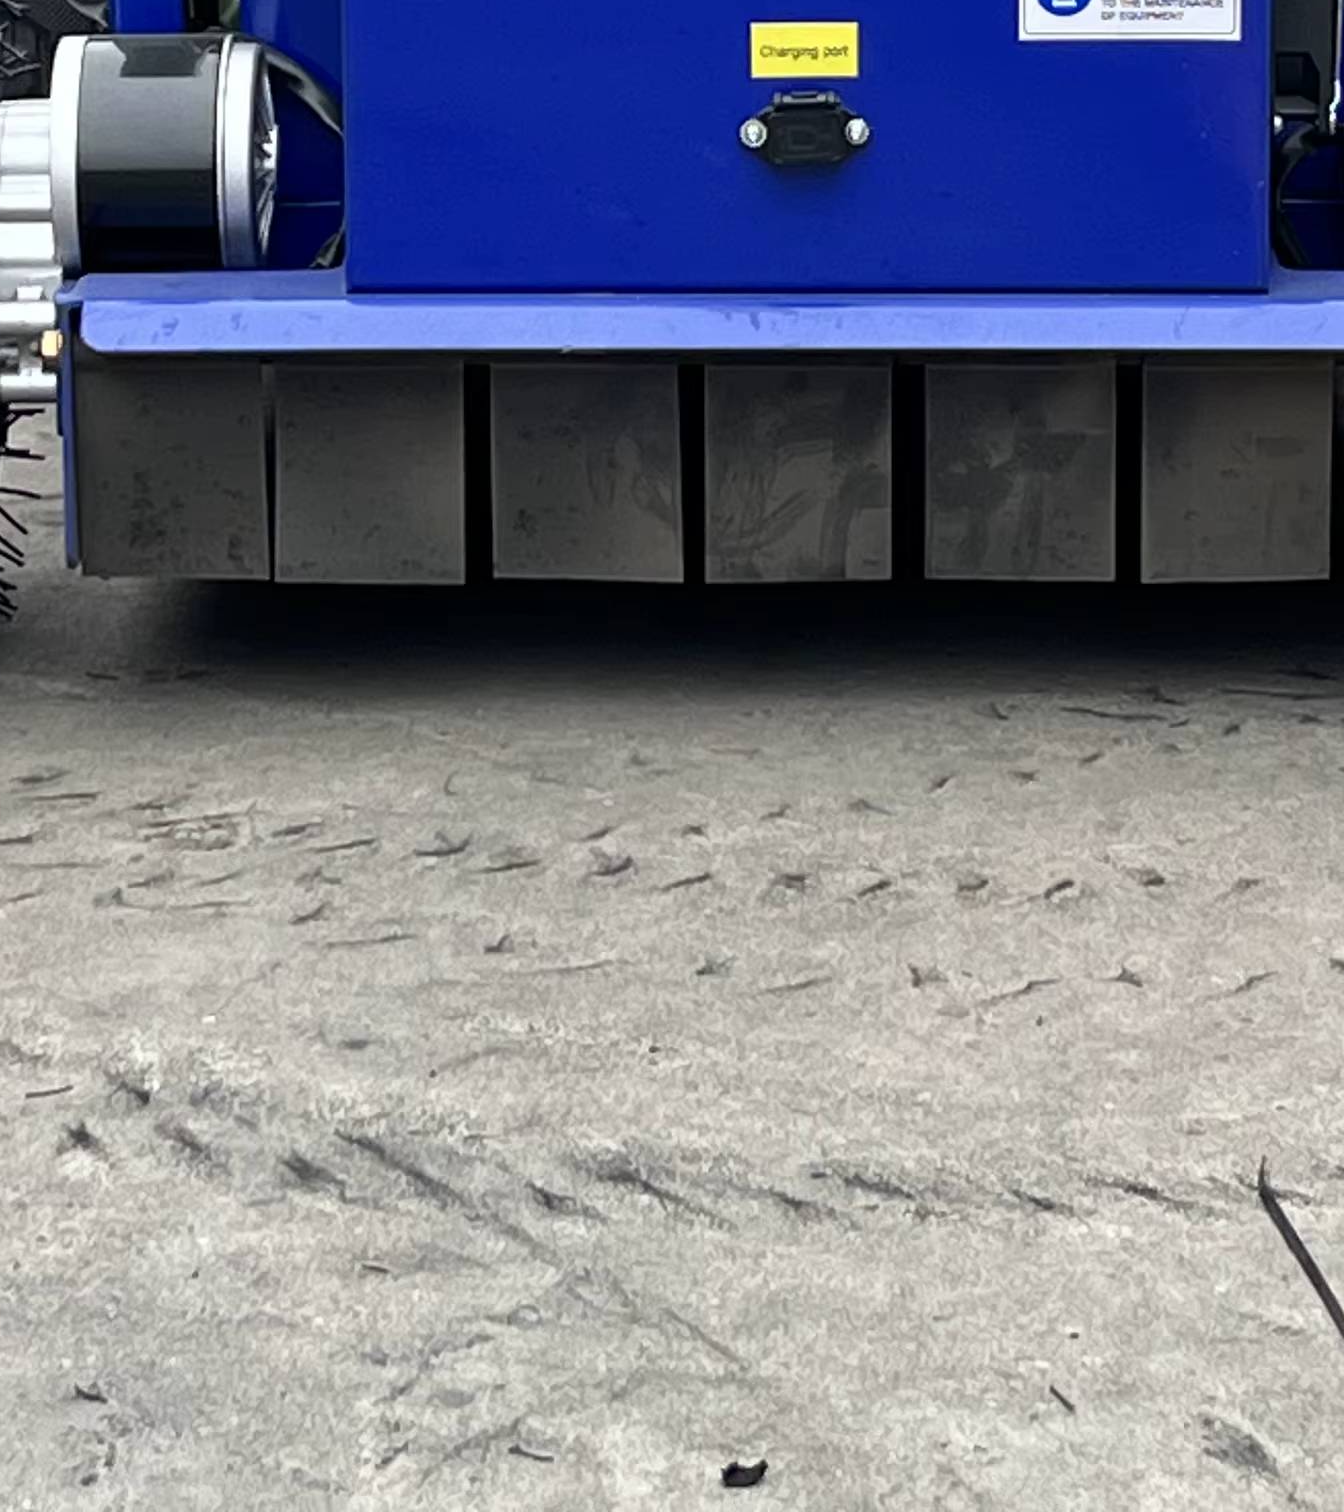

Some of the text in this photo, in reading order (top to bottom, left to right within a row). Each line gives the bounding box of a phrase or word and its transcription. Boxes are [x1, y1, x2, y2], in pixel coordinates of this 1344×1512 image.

[1118, 11, 1185, 21] EQUIPMENT
[759, 44, 849, 60] Charging port
